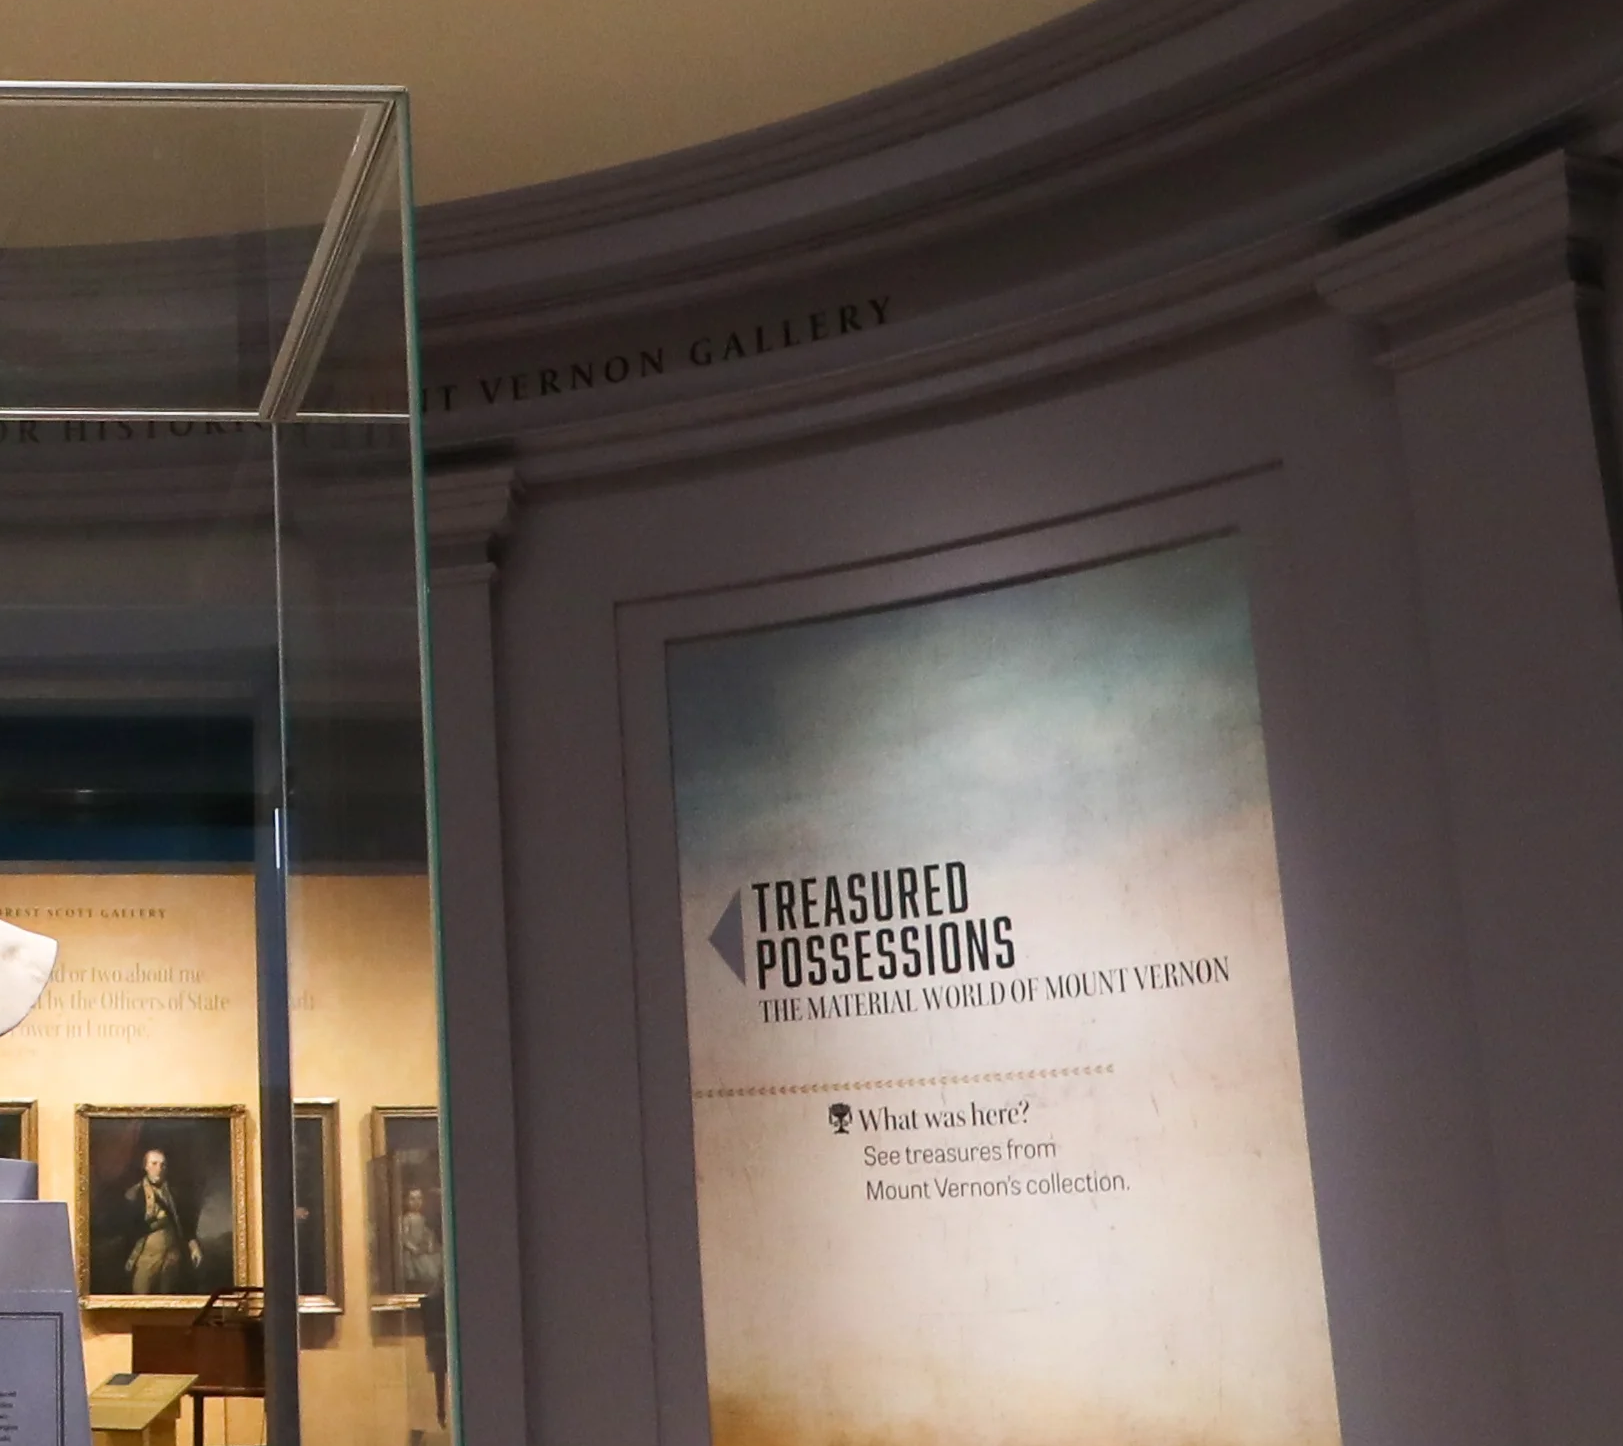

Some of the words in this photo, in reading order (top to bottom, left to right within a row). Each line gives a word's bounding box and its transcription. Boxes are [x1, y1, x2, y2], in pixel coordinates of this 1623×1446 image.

[480, 348, 666, 405] VERNON
[690, 296, 893, 368] GALLERY
[752, 860, 970, 933] TREASURED
[757, 916, 1016, 991] POSSESSIONS
[90, 965, 122, 984] two
[125, 962, 174, 985] about
[758, 998, 803, 1024] THE
[807, 989, 919, 1022] MATERIAL
[921, 980, 1006, 1012] WORLD
[1010, 976, 1040, 1004] OF
[1045, 967, 1129, 1001] MOUNT
[1133, 955, 1231, 992] VERNON
[70, 990, 97, 1010] the
[167, 991, 185, 1011] of
[187, 991, 231, 1011] State
[858, 1106, 919, 1133] What
[924, 1110, 966, 1129] was
[970, 1099, 1030, 1126] here?
[863, 1145, 901, 1168] See
[905, 1143, 1002, 1165] treasures
[1007, 1138, 1057, 1160] from
[866, 1179, 931, 1202] Mount
[934, 1175, 1022, 1198] Vernon's
[1026, 1169, 1131, 1196] collection.
